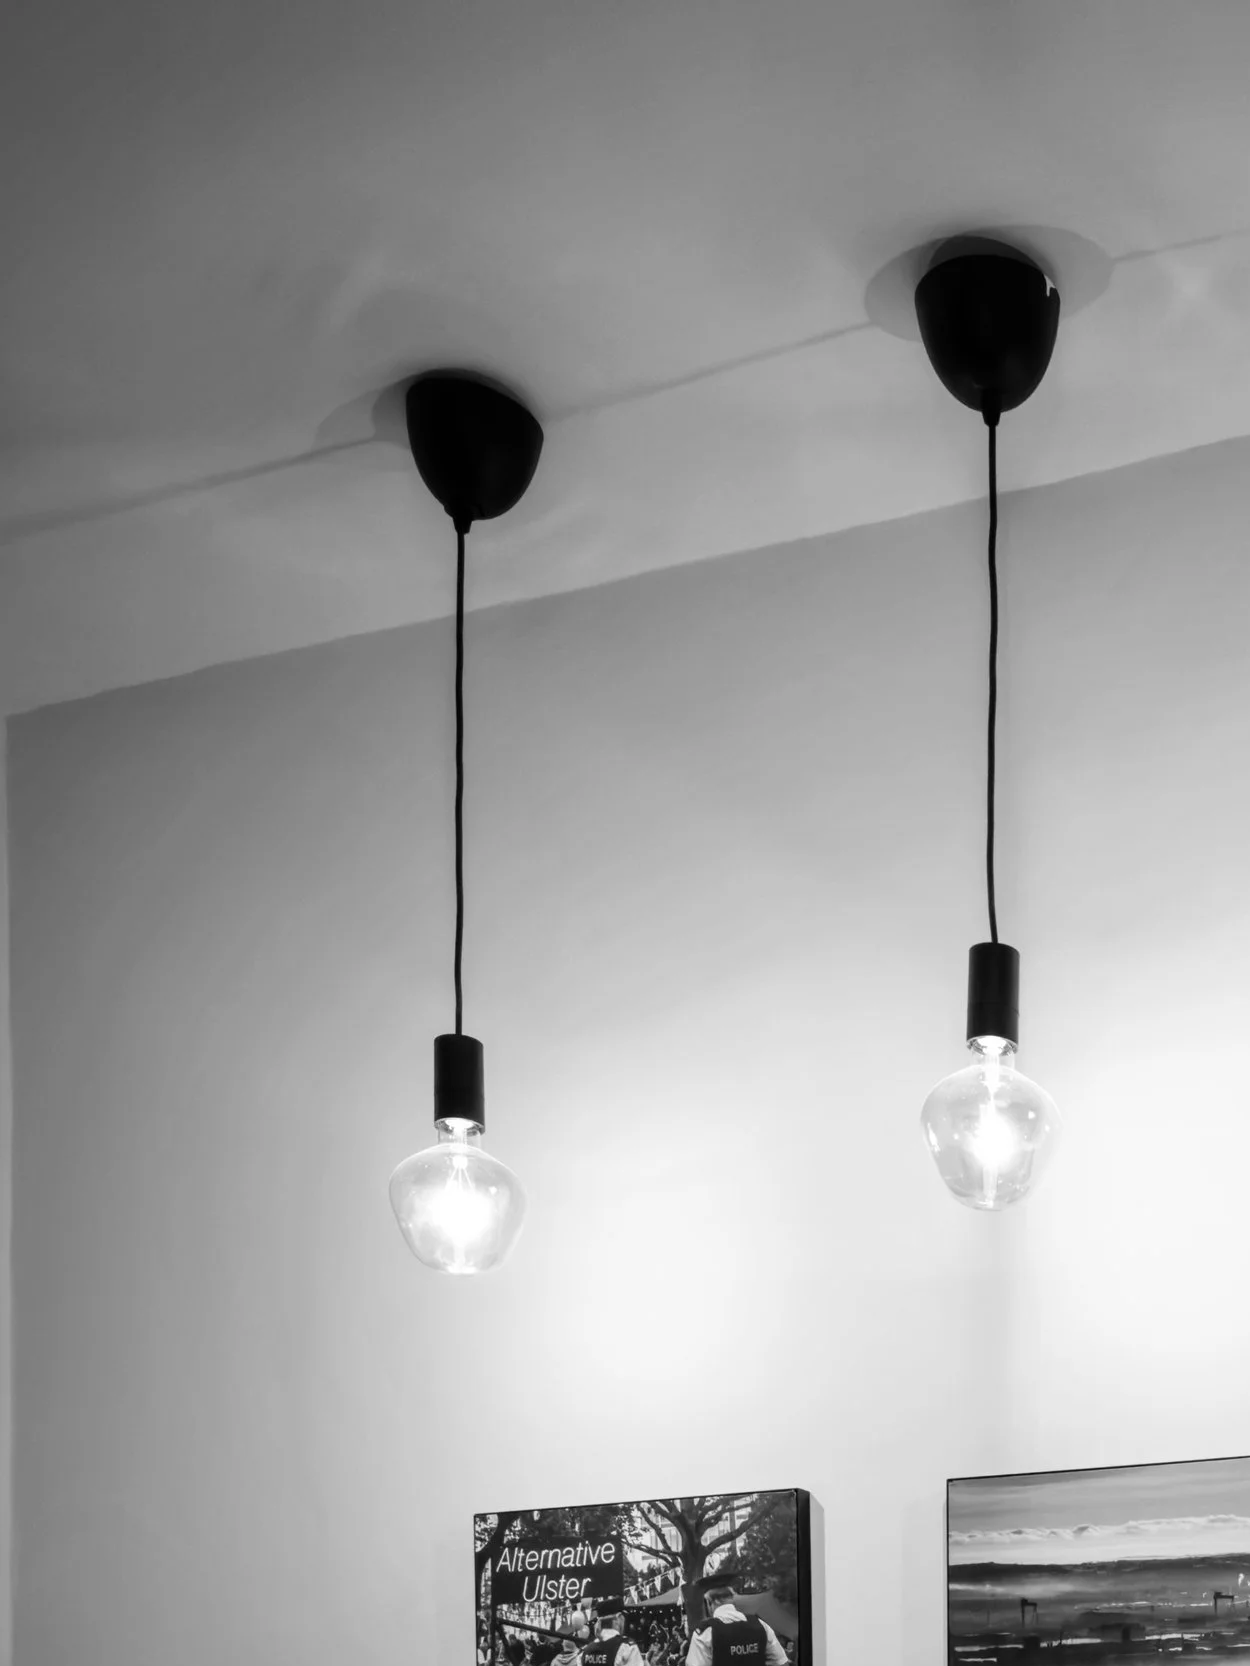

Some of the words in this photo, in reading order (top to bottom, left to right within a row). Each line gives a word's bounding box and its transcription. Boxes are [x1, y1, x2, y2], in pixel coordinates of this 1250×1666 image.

[496, 1541, 615, 1573] Alternative
[523, 1575, 592, 1602] Ulster
[584, 1654, 608, 1664] POLICE
[730, 1643, 759, 1656] POLICE
